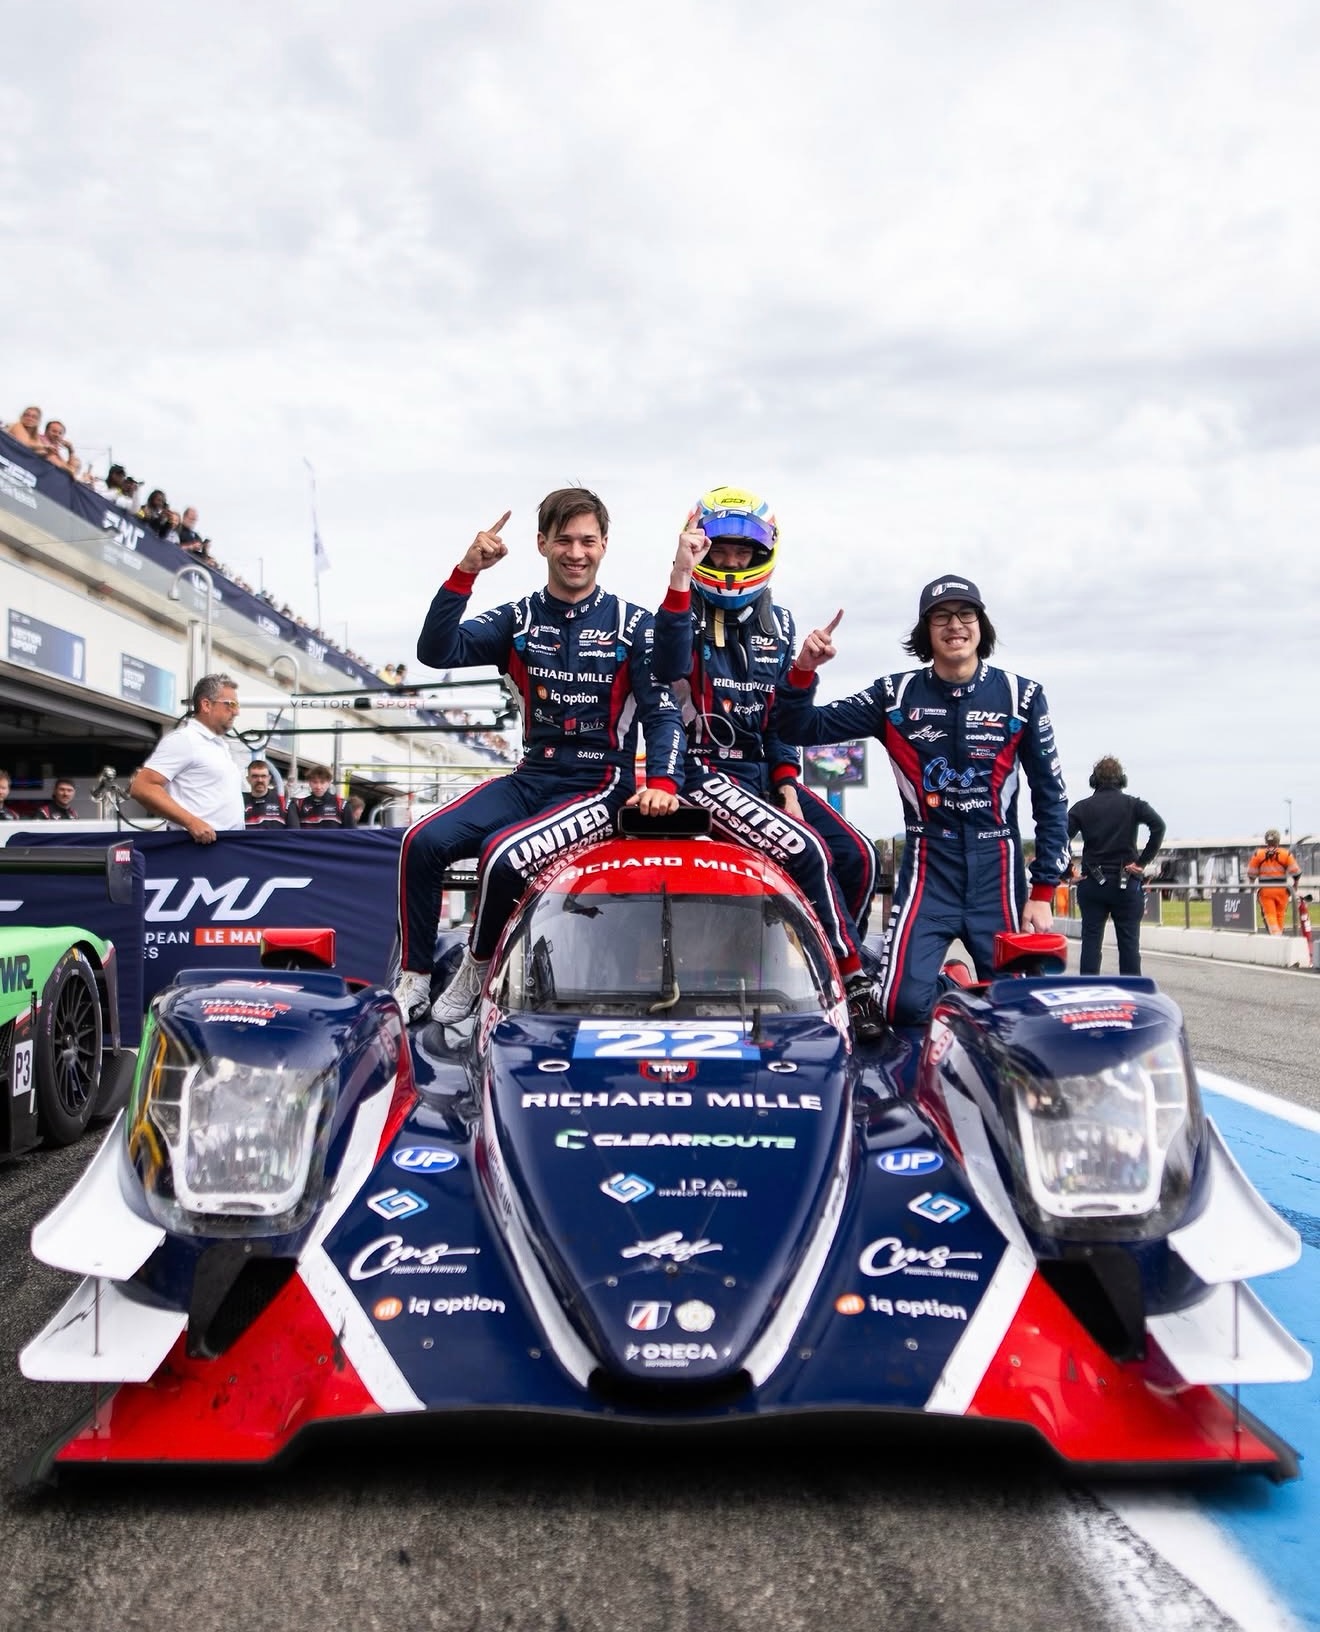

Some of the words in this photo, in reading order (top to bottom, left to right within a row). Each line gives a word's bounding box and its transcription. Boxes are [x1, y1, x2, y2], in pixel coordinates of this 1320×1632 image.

[625, 608, 646, 634] HRX
[579, 629, 617, 640] ELMS
[578, 650, 616, 658] GOODYEAR
[577, 672, 613, 683] MILLE
[551, 689, 561, 704] iq
[562, 692, 598, 705] option
[1021, 681, 1038, 710] HRX
[290, 700, 351, 709] VECTOR
[377, 700, 426, 709] SPORT
[966, 711, 1008, 722] ELMS
[908, 725, 948, 742] Leaf
[965, 733, 1005, 741] GOODYEAR
[577, 751, 604, 760] SAUCY
[944, 797, 955, 809] iq
[956, 799, 991, 812] option
[703, 777, 806, 854] UNITED
[689, 789, 790, 861] AUTOSPORTS
[508, 803, 610, 870] UNITED
[978, 828, 1011, 839] PEEBLES
[559, 856, 683, 883] RICHARD
[694, 857, 776, 886] MILLE
[145, 931, 190, 944] PEAN
[204, 931, 225, 943] LE
[595, 1030, 742, 1058] 22
[15, 1049, 31, 1089] P3
[521, 1092, 692, 1109] RICHARD
[707, 1093, 823, 1111] MILLE
[592, 1133, 796, 1149] CLEARROUTE
[399, 1151, 454, 1167] UP
[885, 1152, 937, 1170] UP
[391, 1265, 430, 1274] PRODUCTION
[903, 1267, 944, 1278] PRODUCTION
[944, 1270, 979, 1281] PERFECTED
[408, 1296, 430, 1316] iq
[434, 1295, 506, 1315] option
[869, 1294, 894, 1316] iq
[895, 1299, 967, 1320] option
[643, 1343, 718, 1360] ORECA
